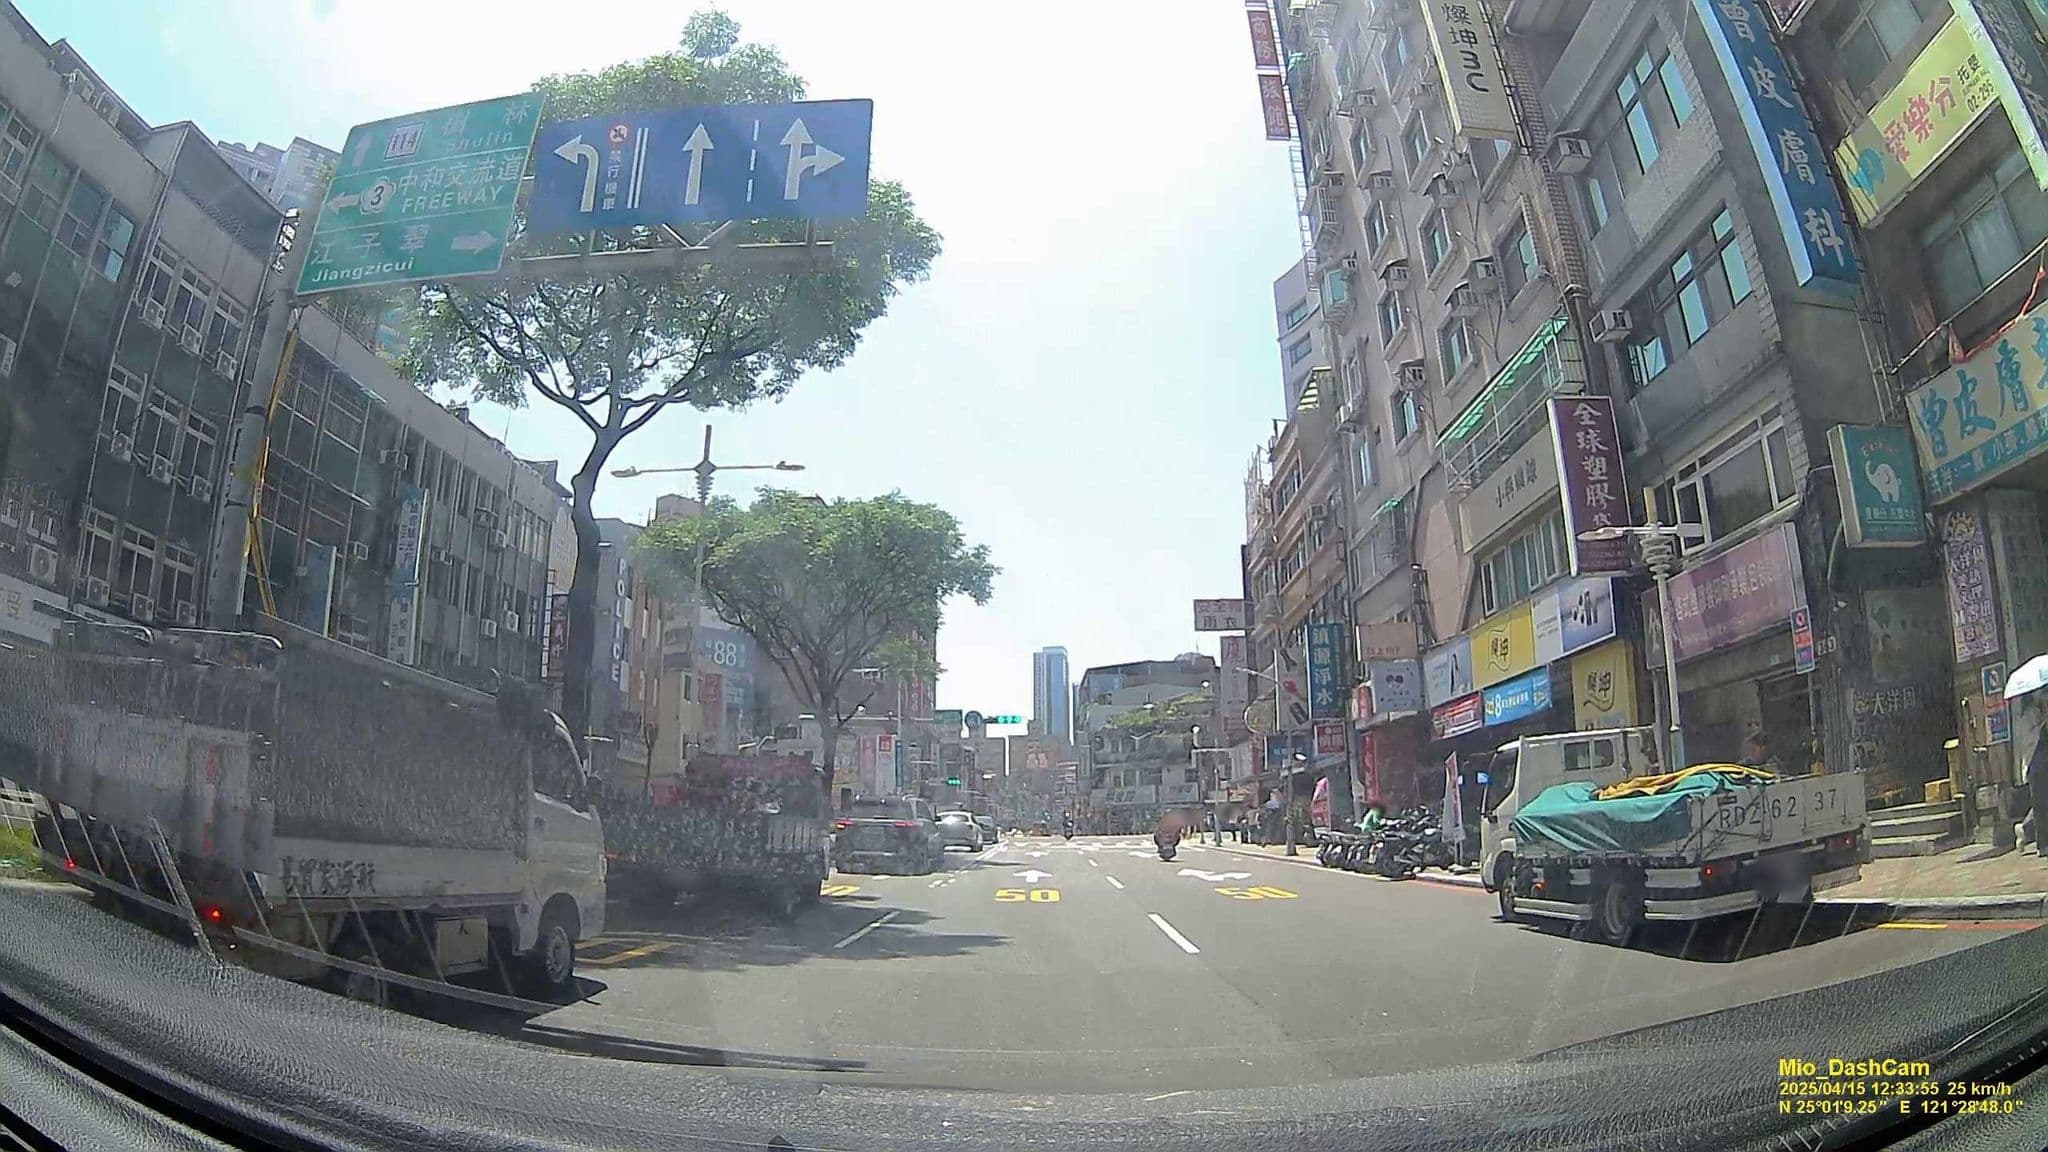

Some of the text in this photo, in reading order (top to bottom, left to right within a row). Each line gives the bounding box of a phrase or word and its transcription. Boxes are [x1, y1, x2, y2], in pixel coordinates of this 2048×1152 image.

[1442, 3, 1489, 93] 燦坤3C
[391, 128, 416, 151] 114
[1718, 0, 1845, 267] 曾皮膚科
[399, 154, 525, 194] 中和交流道
[369, 185, 385, 207] 3
[402, 185, 503, 213] FREEWAY
[310, 223, 429, 265] 江子翠
[311, 256, 415, 283] Jiangzicui
[611, 557, 628, 683] POLICE
[994, 888, 1061, 902] 50
[1213, 885, 1300, 901] 50
